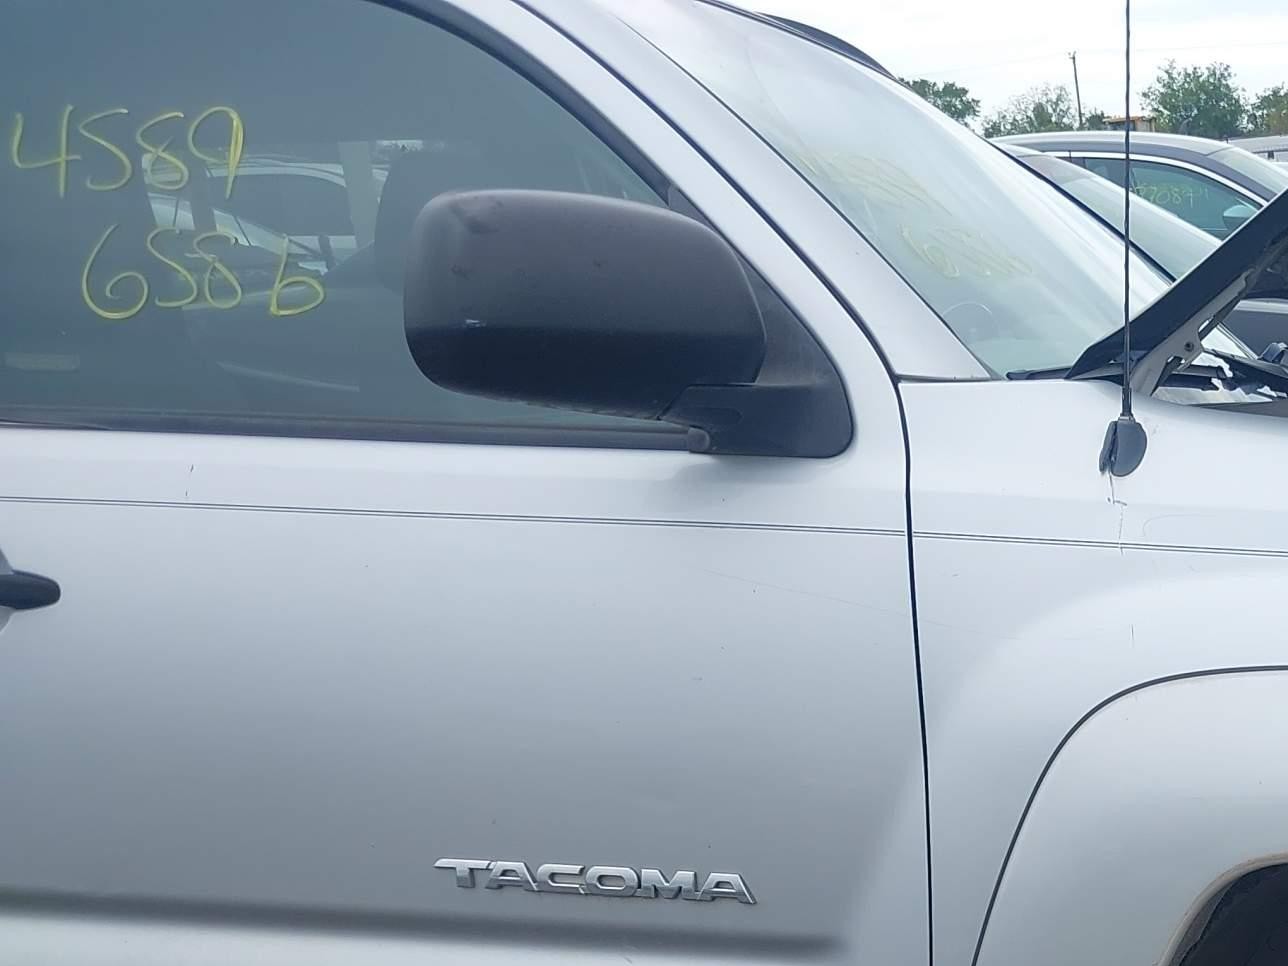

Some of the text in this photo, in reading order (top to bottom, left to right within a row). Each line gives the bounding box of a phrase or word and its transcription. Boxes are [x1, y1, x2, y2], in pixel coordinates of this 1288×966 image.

[12, 104, 244, 199] 4589
[82, 224, 326, 319] 6586
[433, 858, 757, 905] TACOMA
